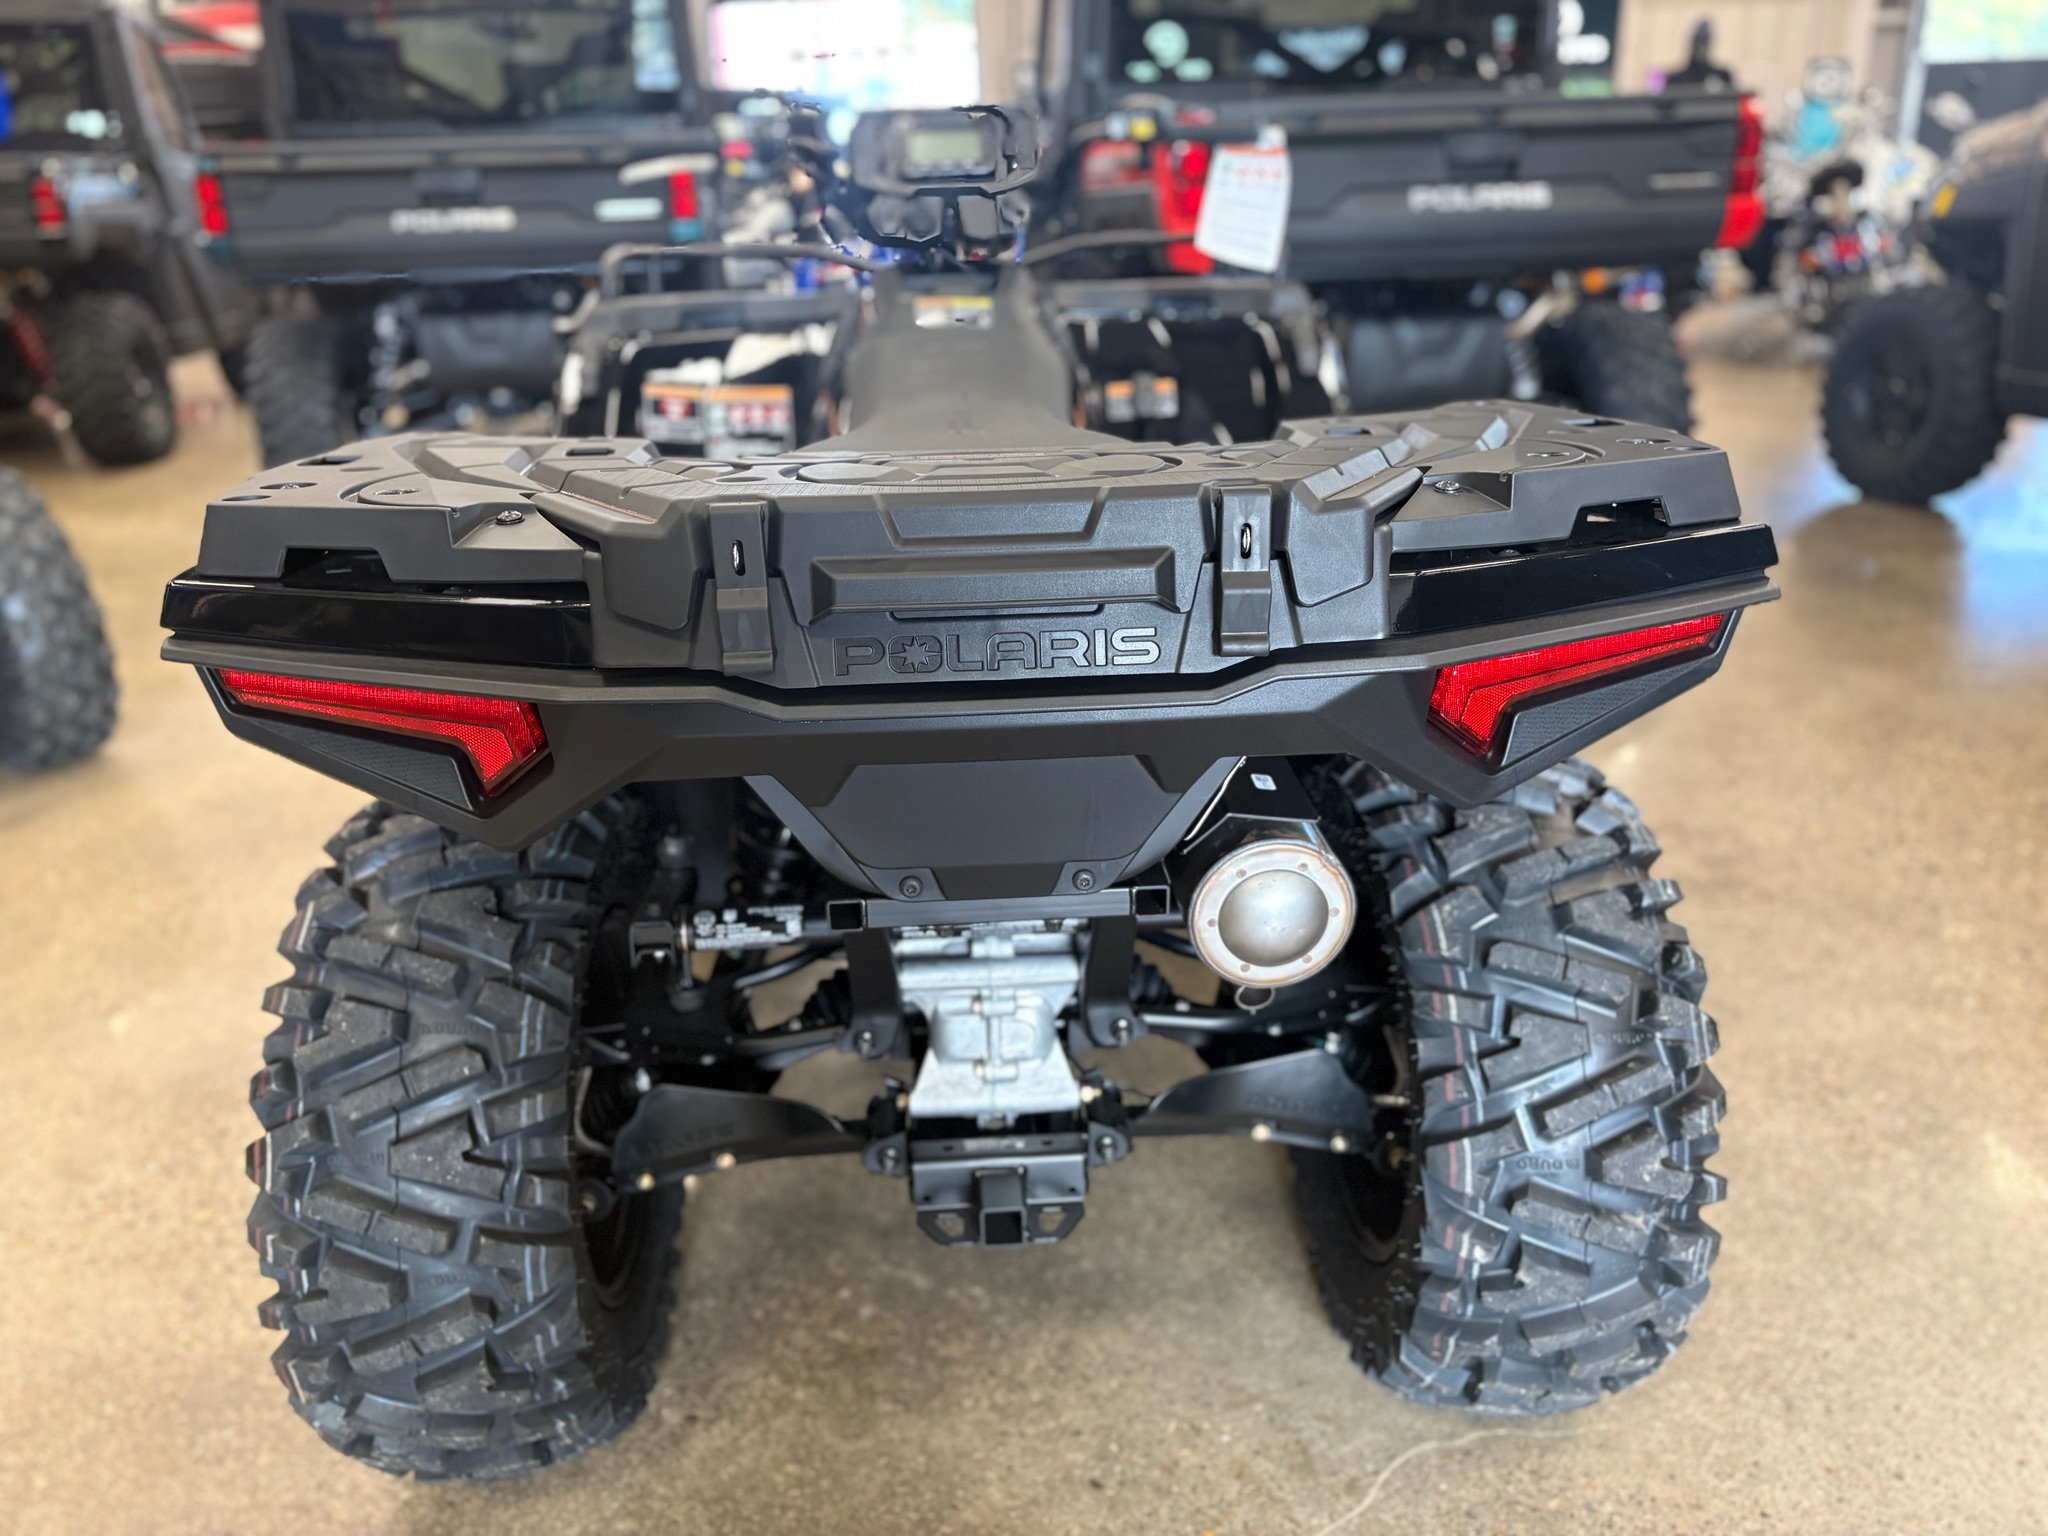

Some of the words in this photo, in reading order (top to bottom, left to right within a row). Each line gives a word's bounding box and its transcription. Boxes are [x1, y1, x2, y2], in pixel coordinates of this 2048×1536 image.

[1407, 180, 1552, 213] POLARIS
[389, 206, 518, 236] POLARIS
[833, 627, 1161, 676] POLARIS
